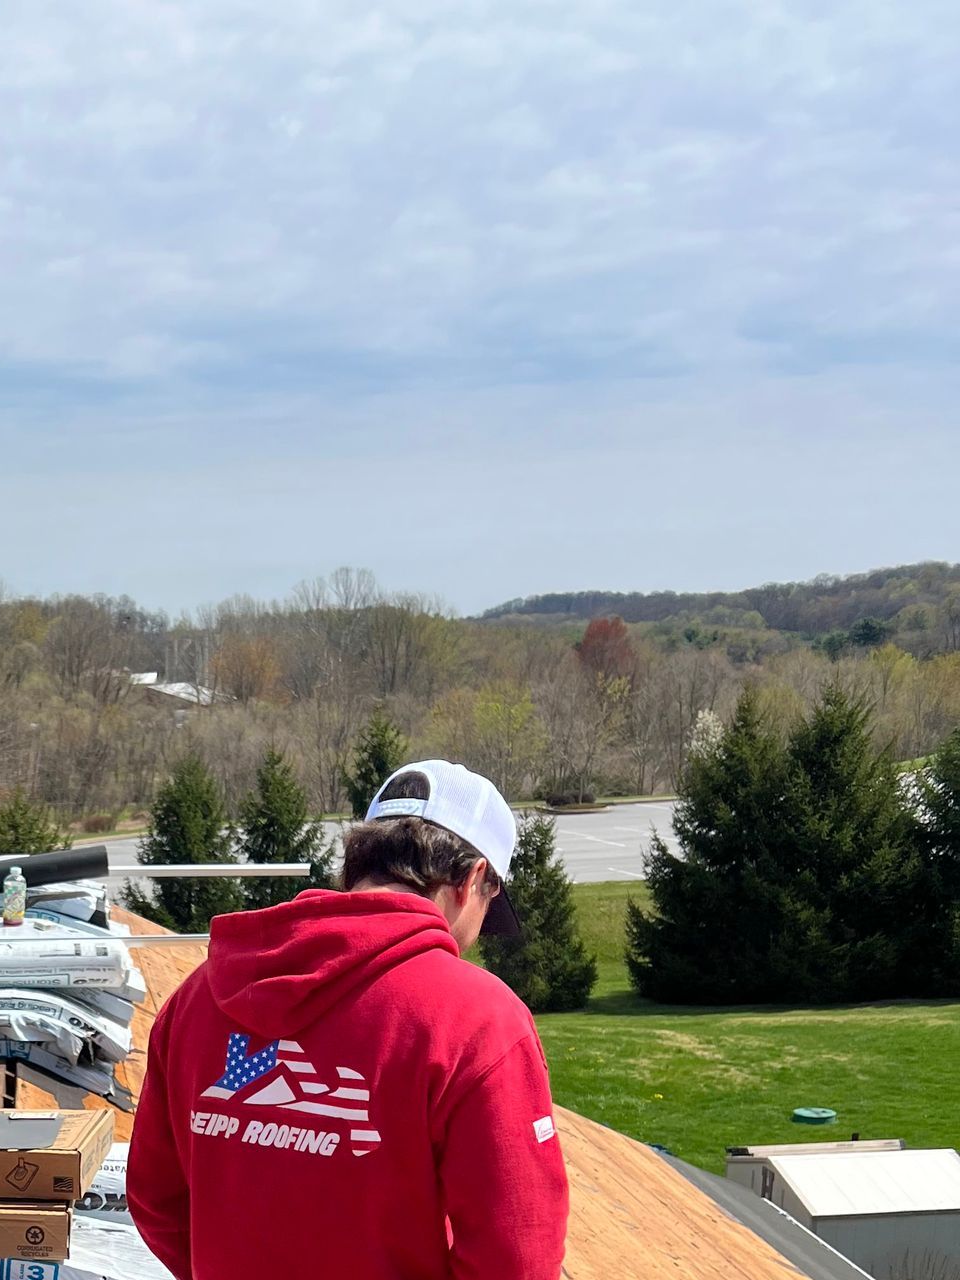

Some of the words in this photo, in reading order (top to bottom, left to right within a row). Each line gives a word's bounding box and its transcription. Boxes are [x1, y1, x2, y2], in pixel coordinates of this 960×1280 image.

[241, 1120, 340, 1156] ROOFING
[74, 1192, 127, 1211] KO
[27, 1265, 44, 1280] 3
